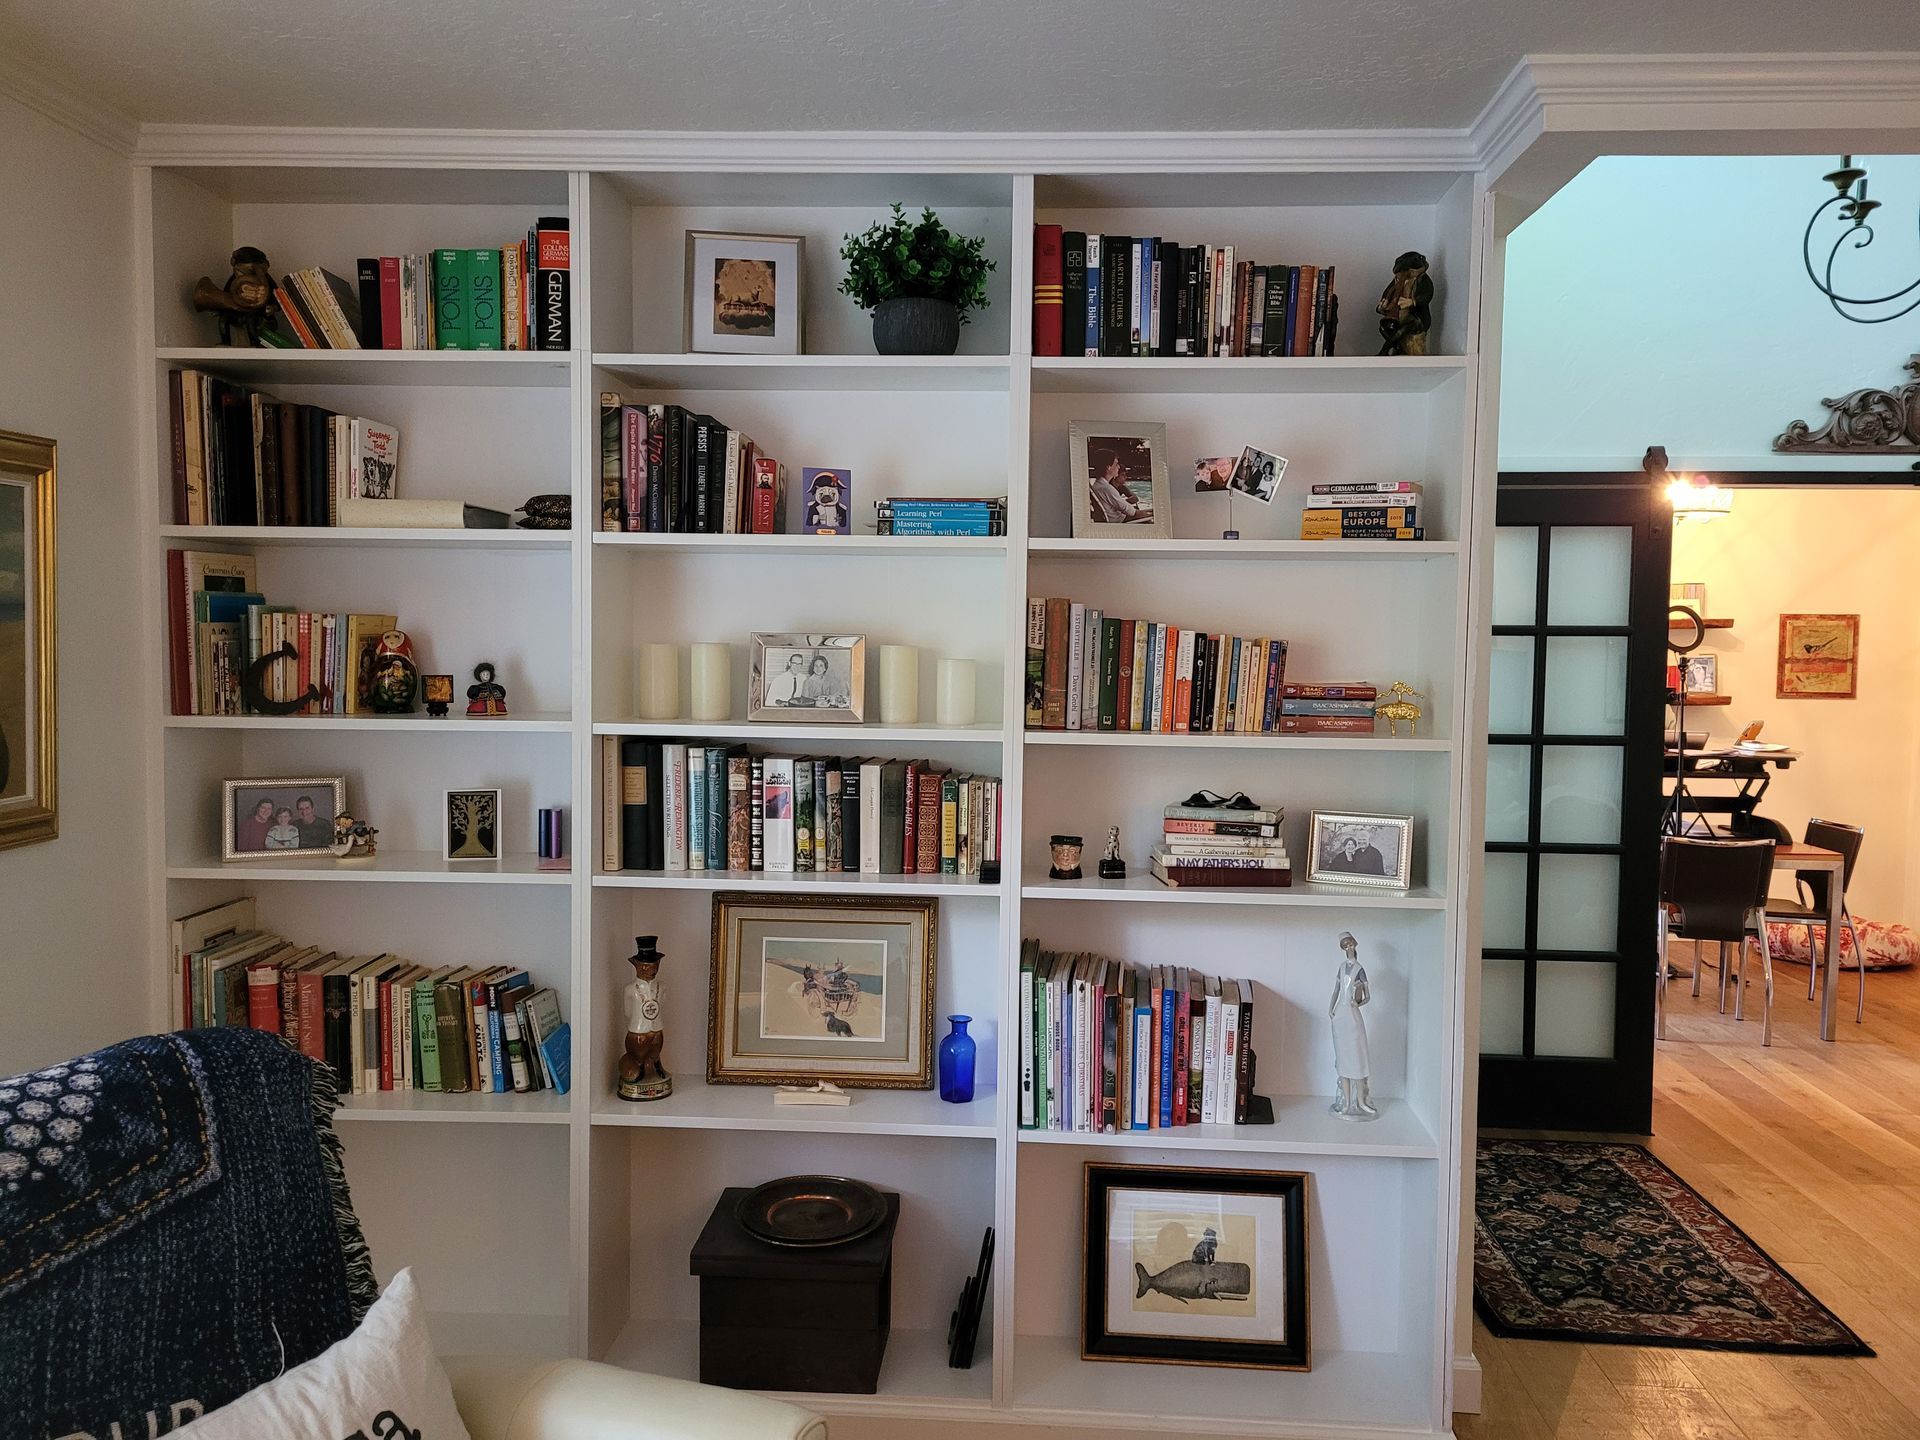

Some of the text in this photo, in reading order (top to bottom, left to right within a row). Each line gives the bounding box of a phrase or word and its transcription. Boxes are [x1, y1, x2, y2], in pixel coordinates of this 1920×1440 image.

[441, 276, 461, 331] PONS
[474, 276, 494, 330] PONS
[549, 271, 563, 342] GERMAN
[1087, 286, 1097, 329] The Bible
[367, 428, 393, 445] Sweeney
[372, 440, 387, 451] Todd
[649, 434, 664, 466] 1776
[671, 410, 680, 467] CARL SAGAN
[698, 426, 707, 453] PERSIST
[698, 465, 706, 516] ELIZABETH WARREN
[762, 494, 770, 526] GRANT
[896, 521, 932, 529] Mastering
[897, 510, 927, 518] Learning
[1343, 517, 1387, 526] EUROPE
[896, 528, 937, 536] Algorithms
[1071, 675, 1079, 712] Dave Grohl
[1154, 684, 1162, 713] MacDonald
[674, 760, 684, 850] FREDERIC REMINGTON
[693, 782, 704, 819] WONDROUS
[693, 821, 704, 850] SINGER!
[708, 809, 723, 858] Shakespeare
[905, 806, 913, 837] FABLES
[1176, 857, 1241, 868] IN MY FATHER'S
[283, 982, 298, 1012] Dictionary
[488, 986, 496, 1008] MOON
[1207, 1001, 1215, 1025] 10-DAY
[285, 1021, 299, 1038] Word
[301, 983, 313, 1053] Manual of Style
[475, 1024, 484, 1062] KNOTS
[493, 1039, 503, 1075] CAMPING
[1178, 1016, 1186, 1072] GRILL SMOKE BBQ
[1194, 1020, 1202, 1067] SONOMA DIET
[1241, 1012, 1251, 1074] TASTING WHISKEY
